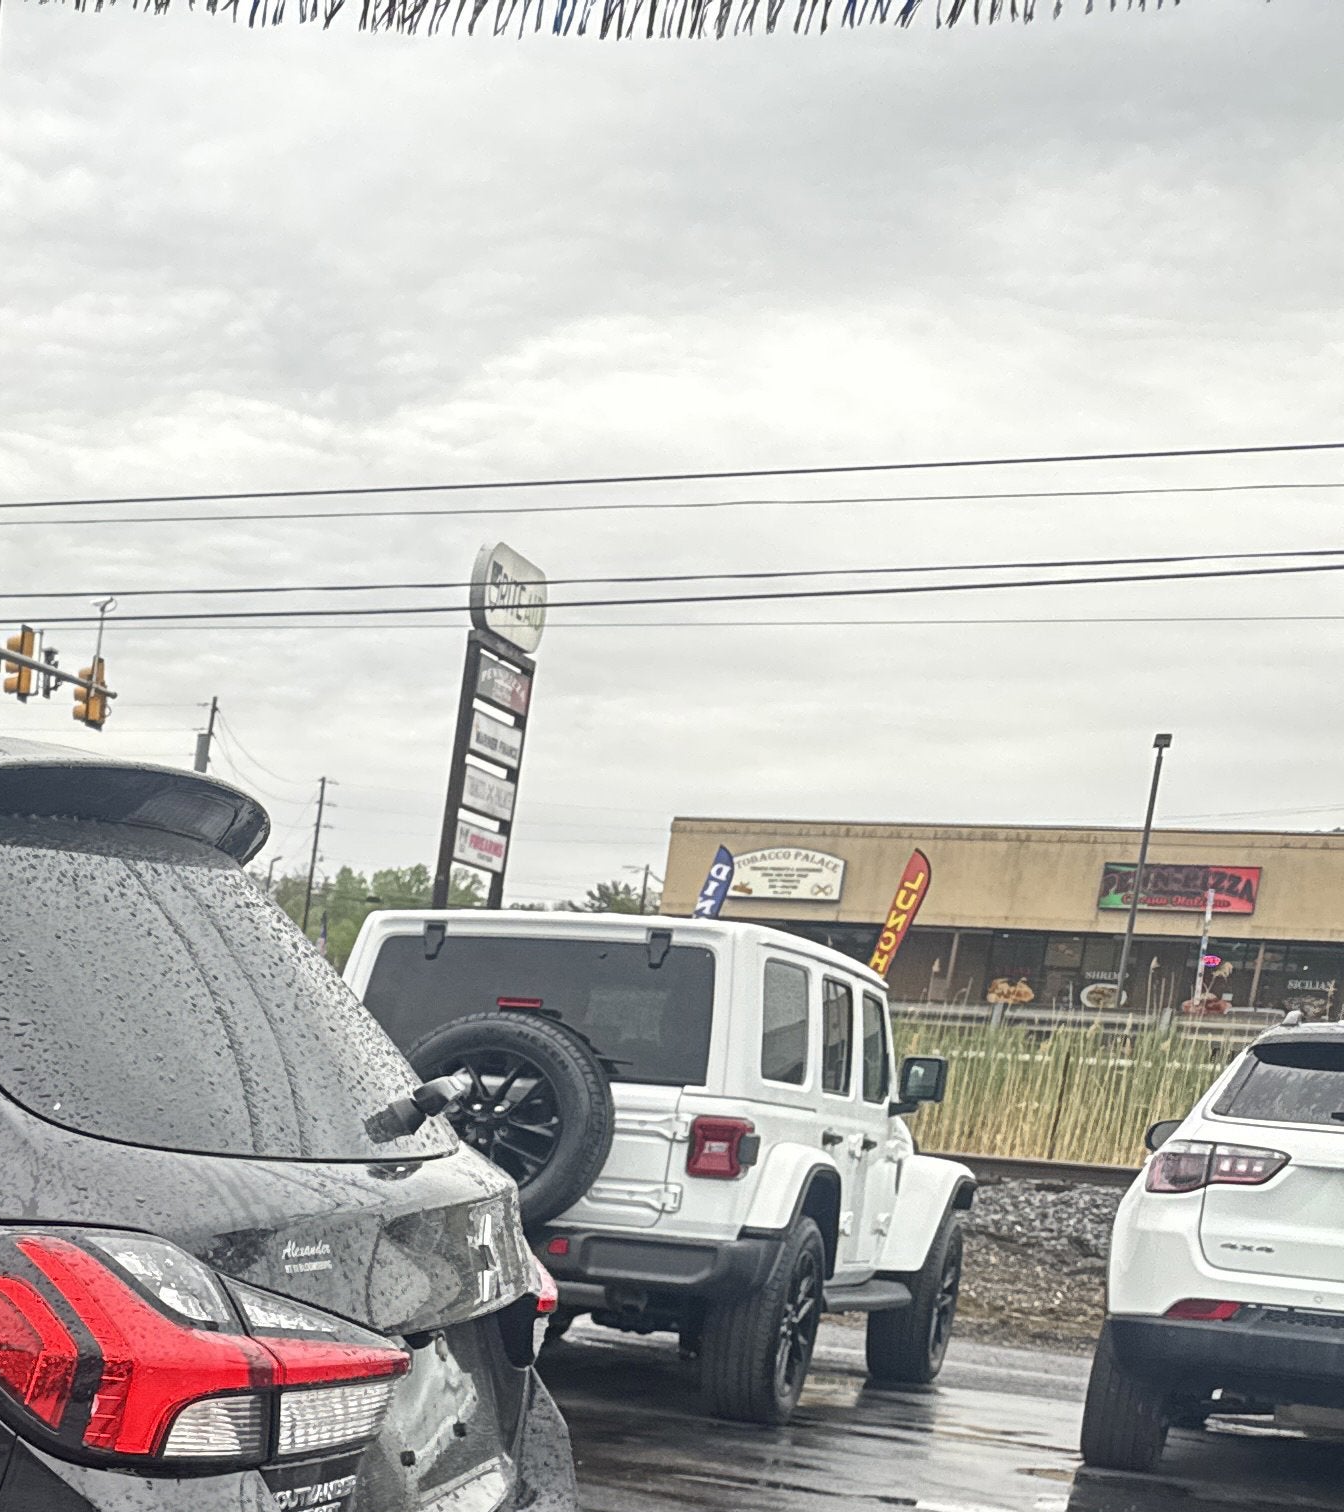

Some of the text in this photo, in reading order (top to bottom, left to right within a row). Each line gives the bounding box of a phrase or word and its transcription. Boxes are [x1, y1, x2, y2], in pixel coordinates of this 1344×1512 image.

[736, 850, 840, 874] TOBACCO PALACE
[282, 1239, 331, 1260] Alexander
